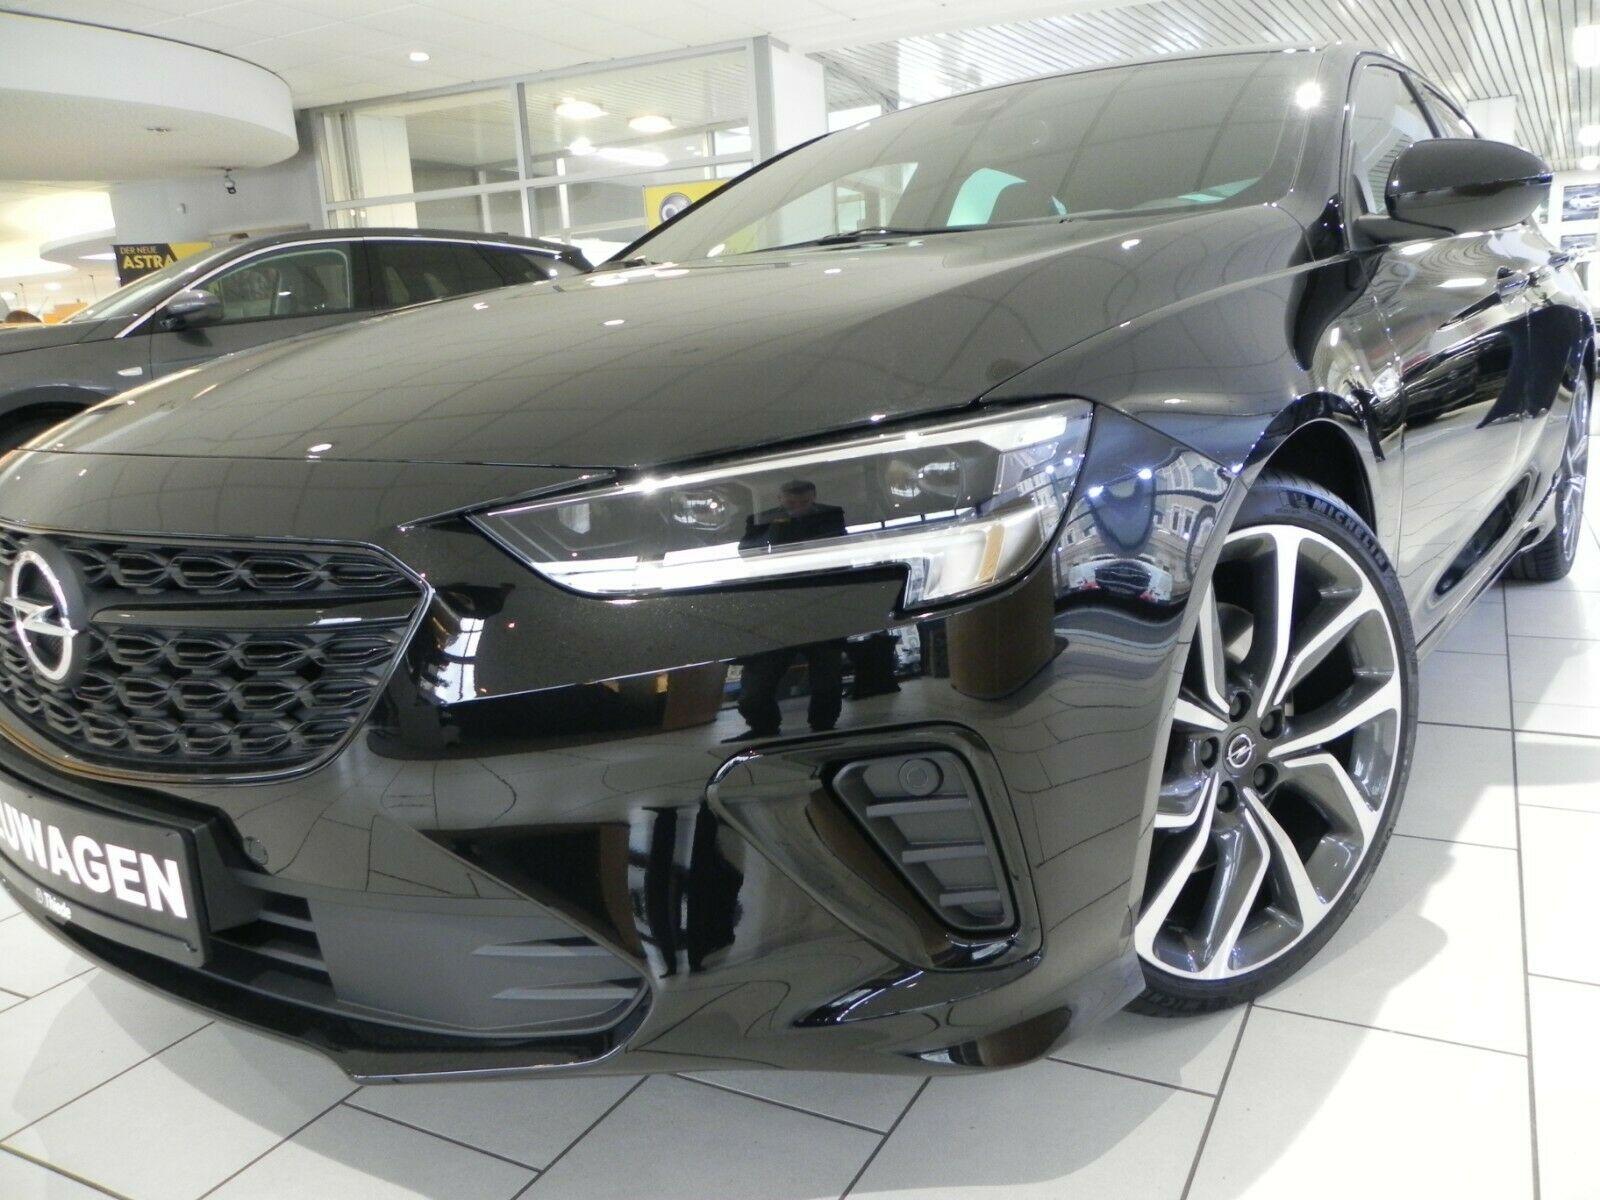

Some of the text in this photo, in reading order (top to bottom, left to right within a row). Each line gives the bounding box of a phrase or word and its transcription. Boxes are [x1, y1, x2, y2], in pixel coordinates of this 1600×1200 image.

[121, 246, 157, 254] DER NEUE
[123, 254, 174, 269] ASTRA
[1312, 498, 1389, 569] MICHELIN
[0, 800, 187, 918] UWAGEN
